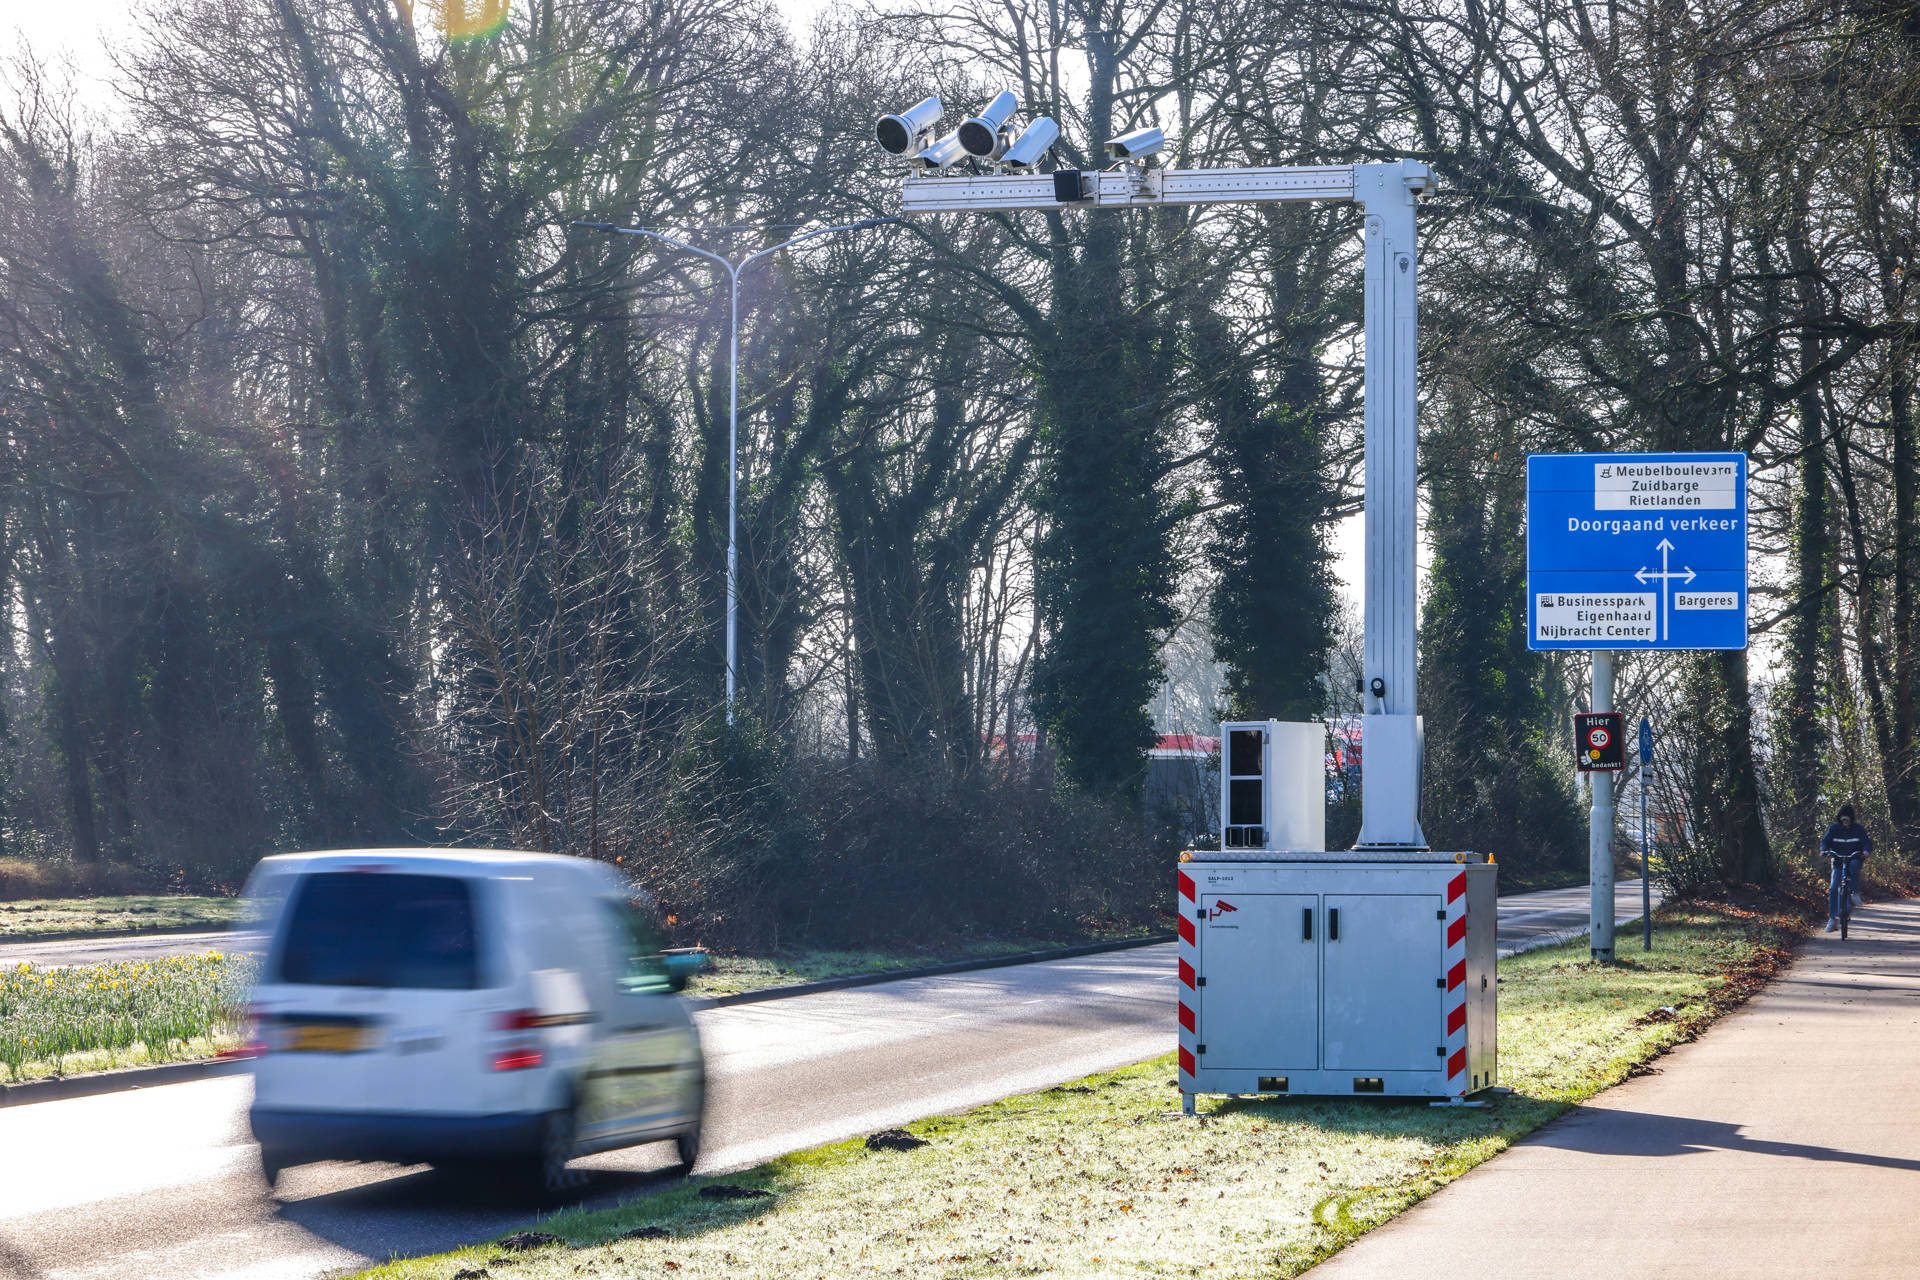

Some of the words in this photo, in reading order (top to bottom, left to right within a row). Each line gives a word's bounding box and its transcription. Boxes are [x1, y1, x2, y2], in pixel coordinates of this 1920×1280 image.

[1632, 481, 1699, 493] Zuidbarge
[1629, 495, 1701, 506] Rietlanden
[1568, 517, 1664, 534] Doorgaand
[1671, 517, 1738, 531] verkeer
[1558, 597, 1645, 609] Businesspark
[1679, 596, 1733, 608] Bargeres
[1577, 611, 1651, 624] Eigenhaard
[1541, 625, 1602, 639] Nijbracht
[1607, 625, 1651, 636] Center
[1587, 717, 1610, 726] Hier
[1592, 734, 1606, 742] 50
